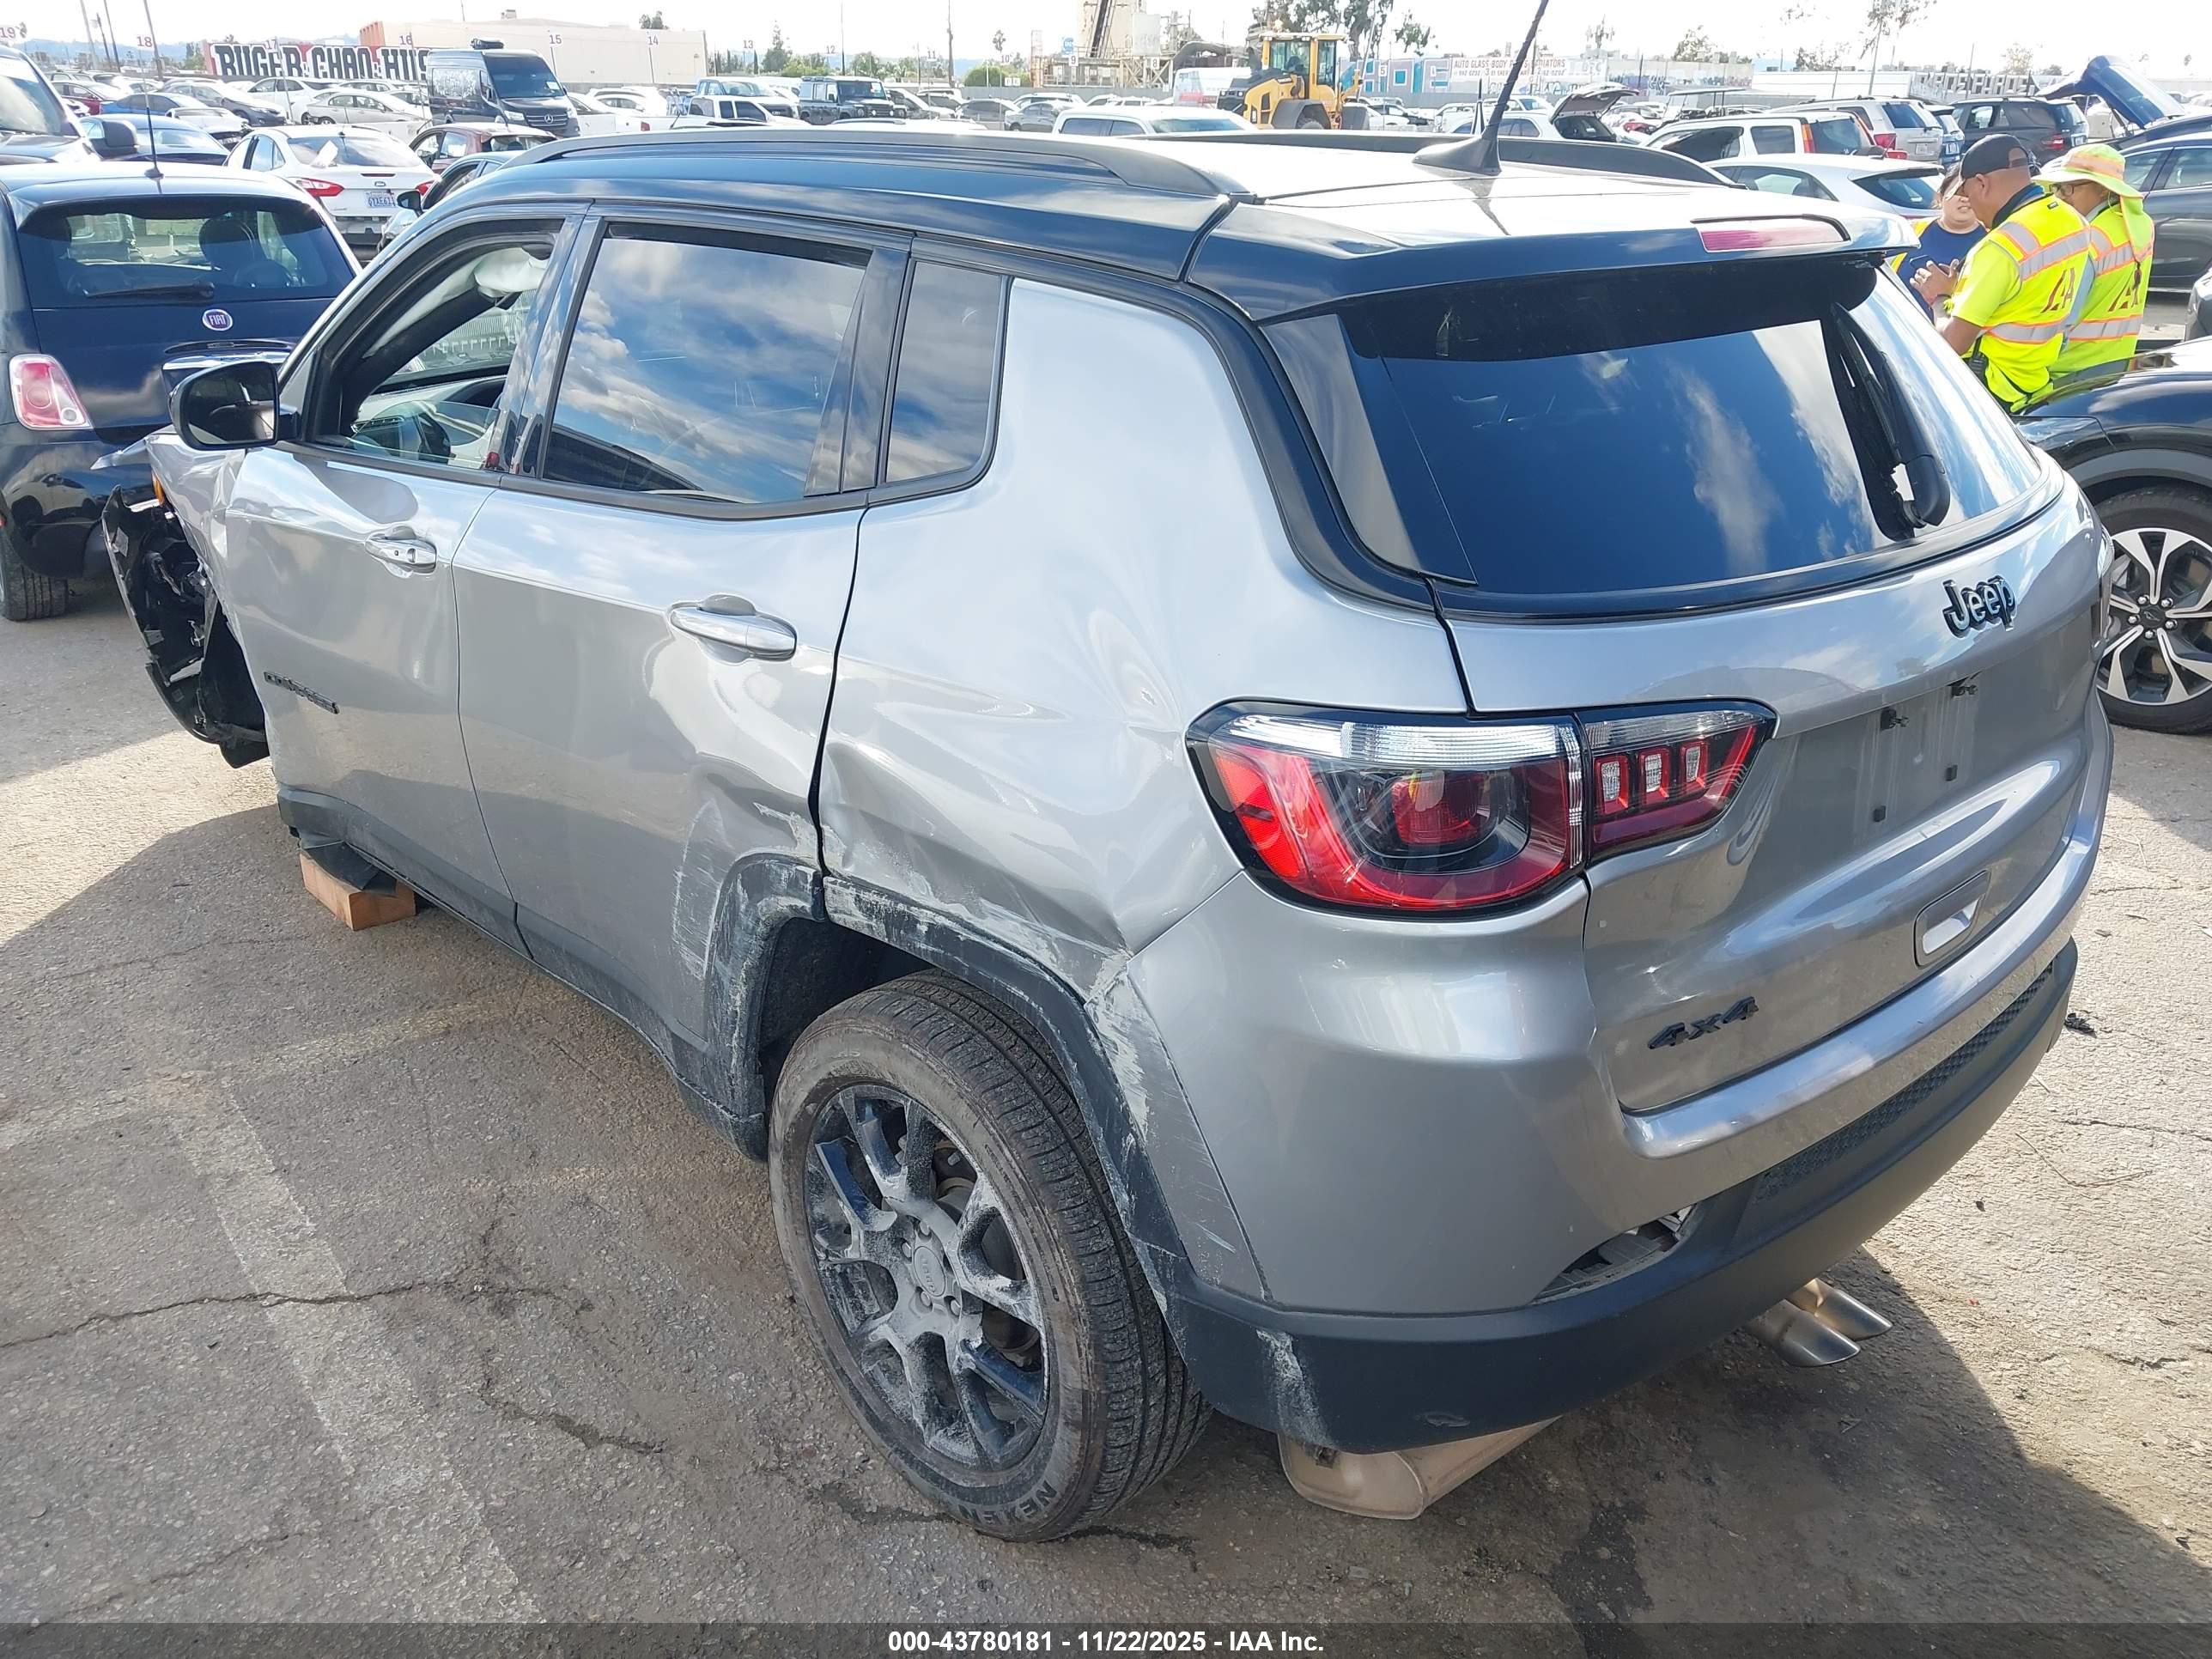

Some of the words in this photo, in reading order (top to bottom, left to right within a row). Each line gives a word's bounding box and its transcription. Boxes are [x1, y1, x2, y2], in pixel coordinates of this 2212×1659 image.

[0, 27, 15, 39] 19
[137, 35, 153, 47] 18
[400, 35, 413, 46] 16
[550, 34, 562, 45] 15
[648, 36, 659, 46] 14
[743, 40, 754, 49] 13
[826, 45, 836, 54] 12
[1454, 59, 1469, 69] AUTO
[208, 314, 227, 325] FIAT
[1942, 574, 2017, 639] Jeep
